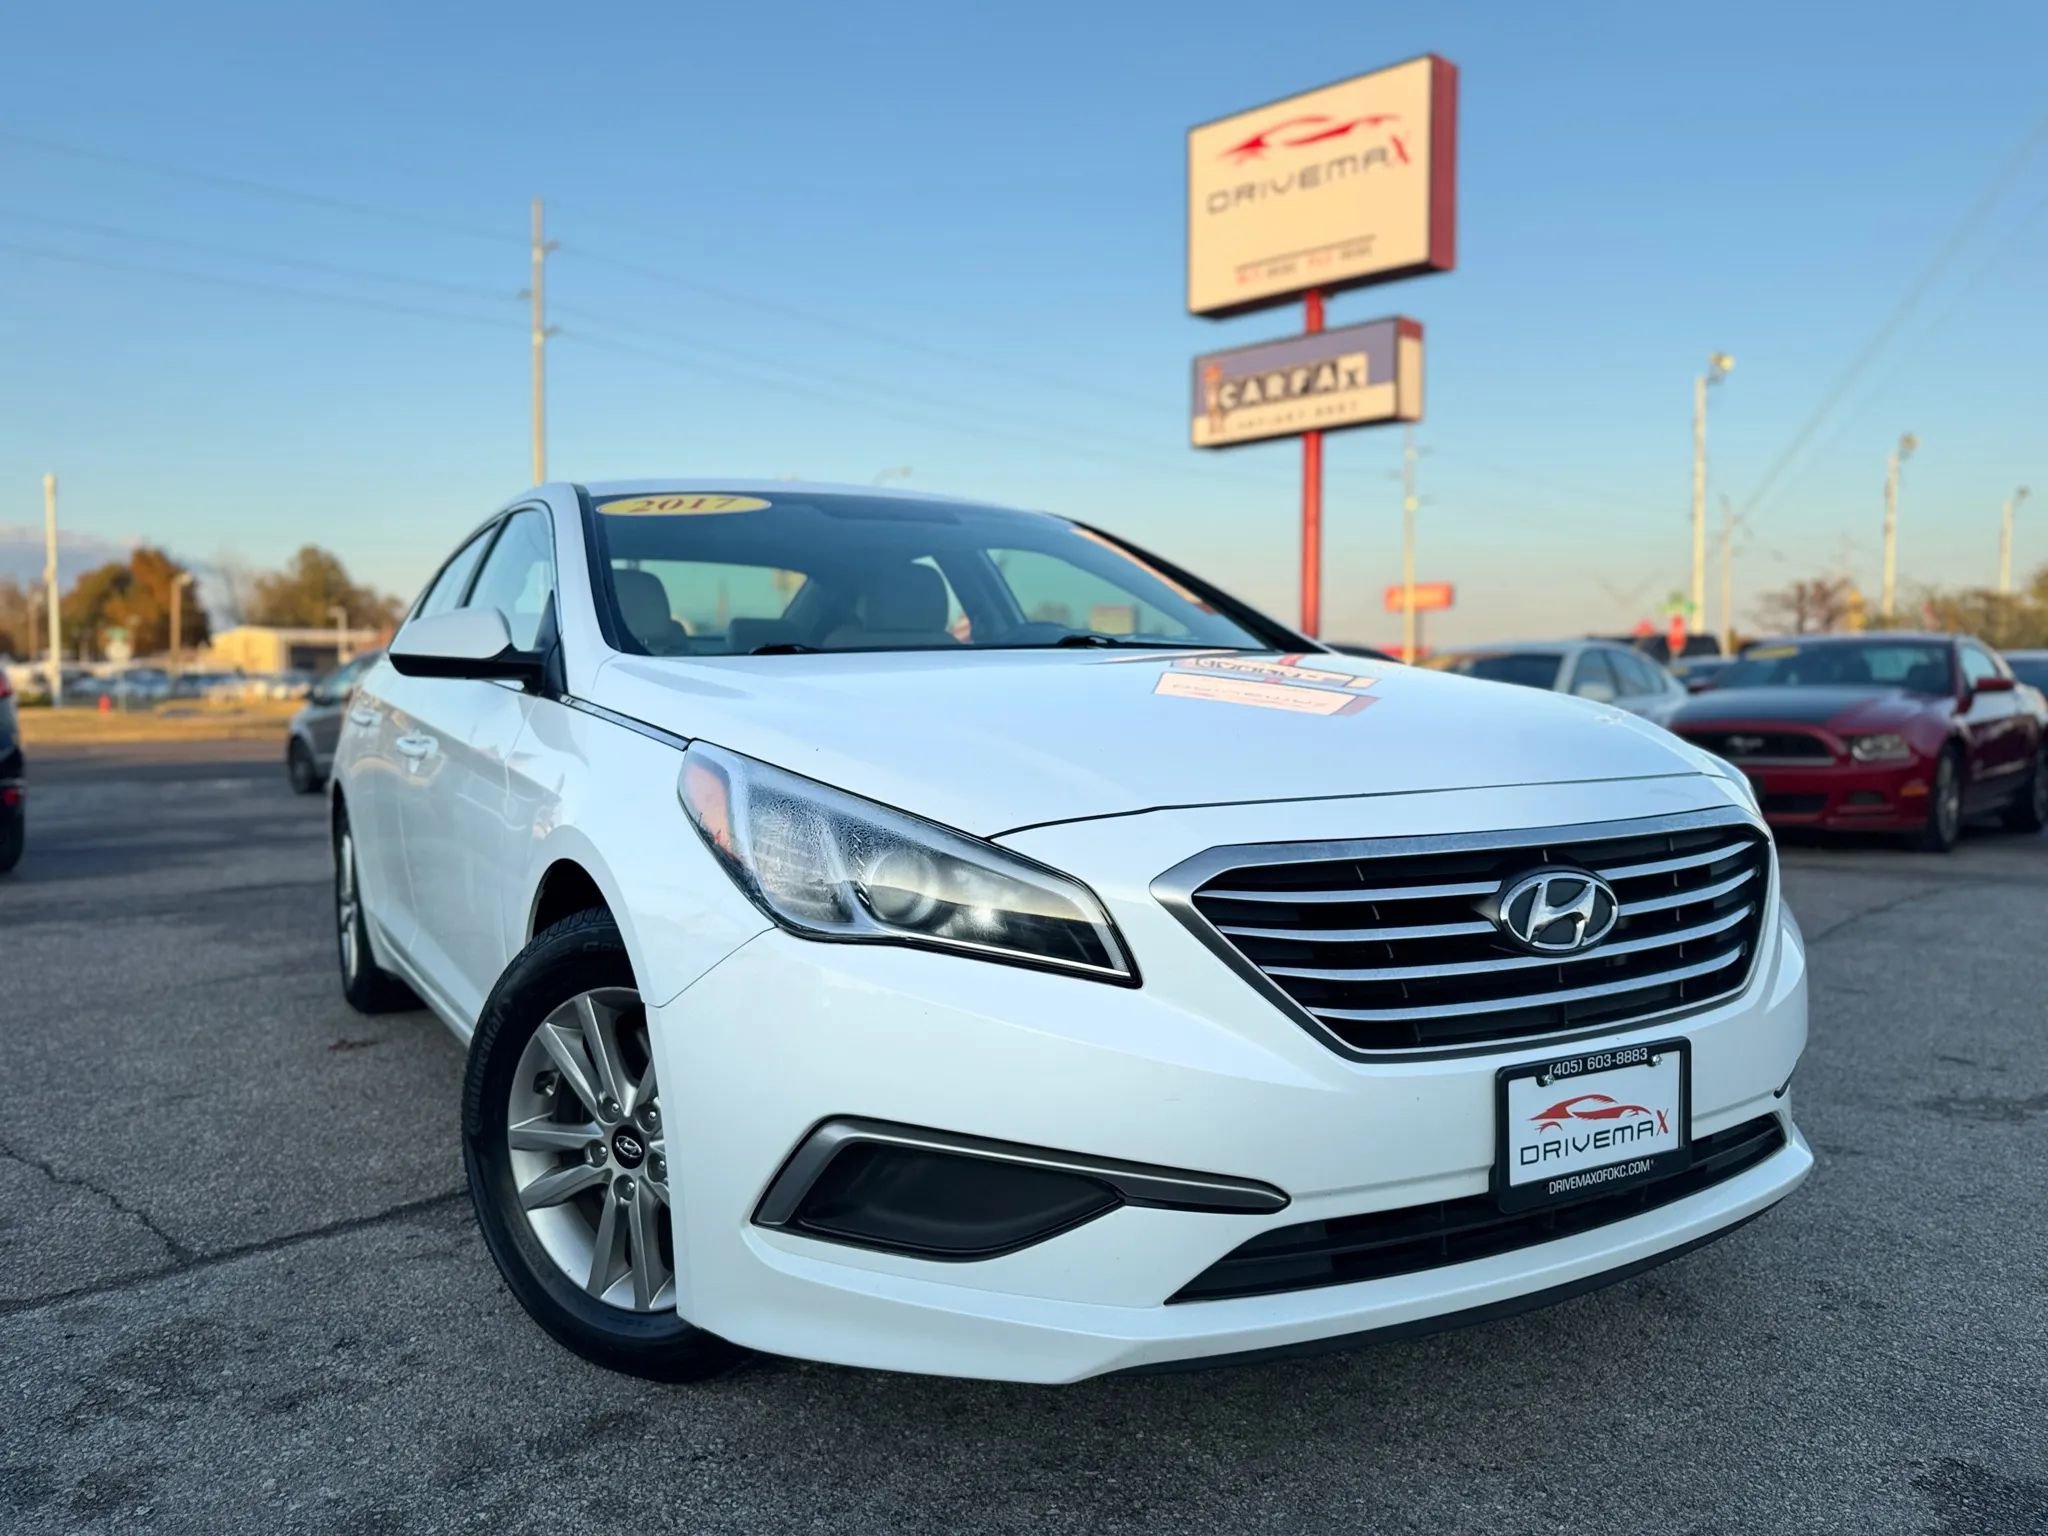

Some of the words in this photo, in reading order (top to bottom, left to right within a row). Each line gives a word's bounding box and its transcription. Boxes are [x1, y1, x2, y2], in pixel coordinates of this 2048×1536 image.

[1206, 130, 1411, 215] DRIVEMAX
[628, 497, 738, 514] 2017
[1549, 1059, 1583, 1077] (405)
[1587, 1048, 1648, 1071] 603-8883
[1520, 1108, 1669, 1165] DRIVEMAX
[1549, 1159, 1650, 1194] DRIVEMAXOFOKC.COM
